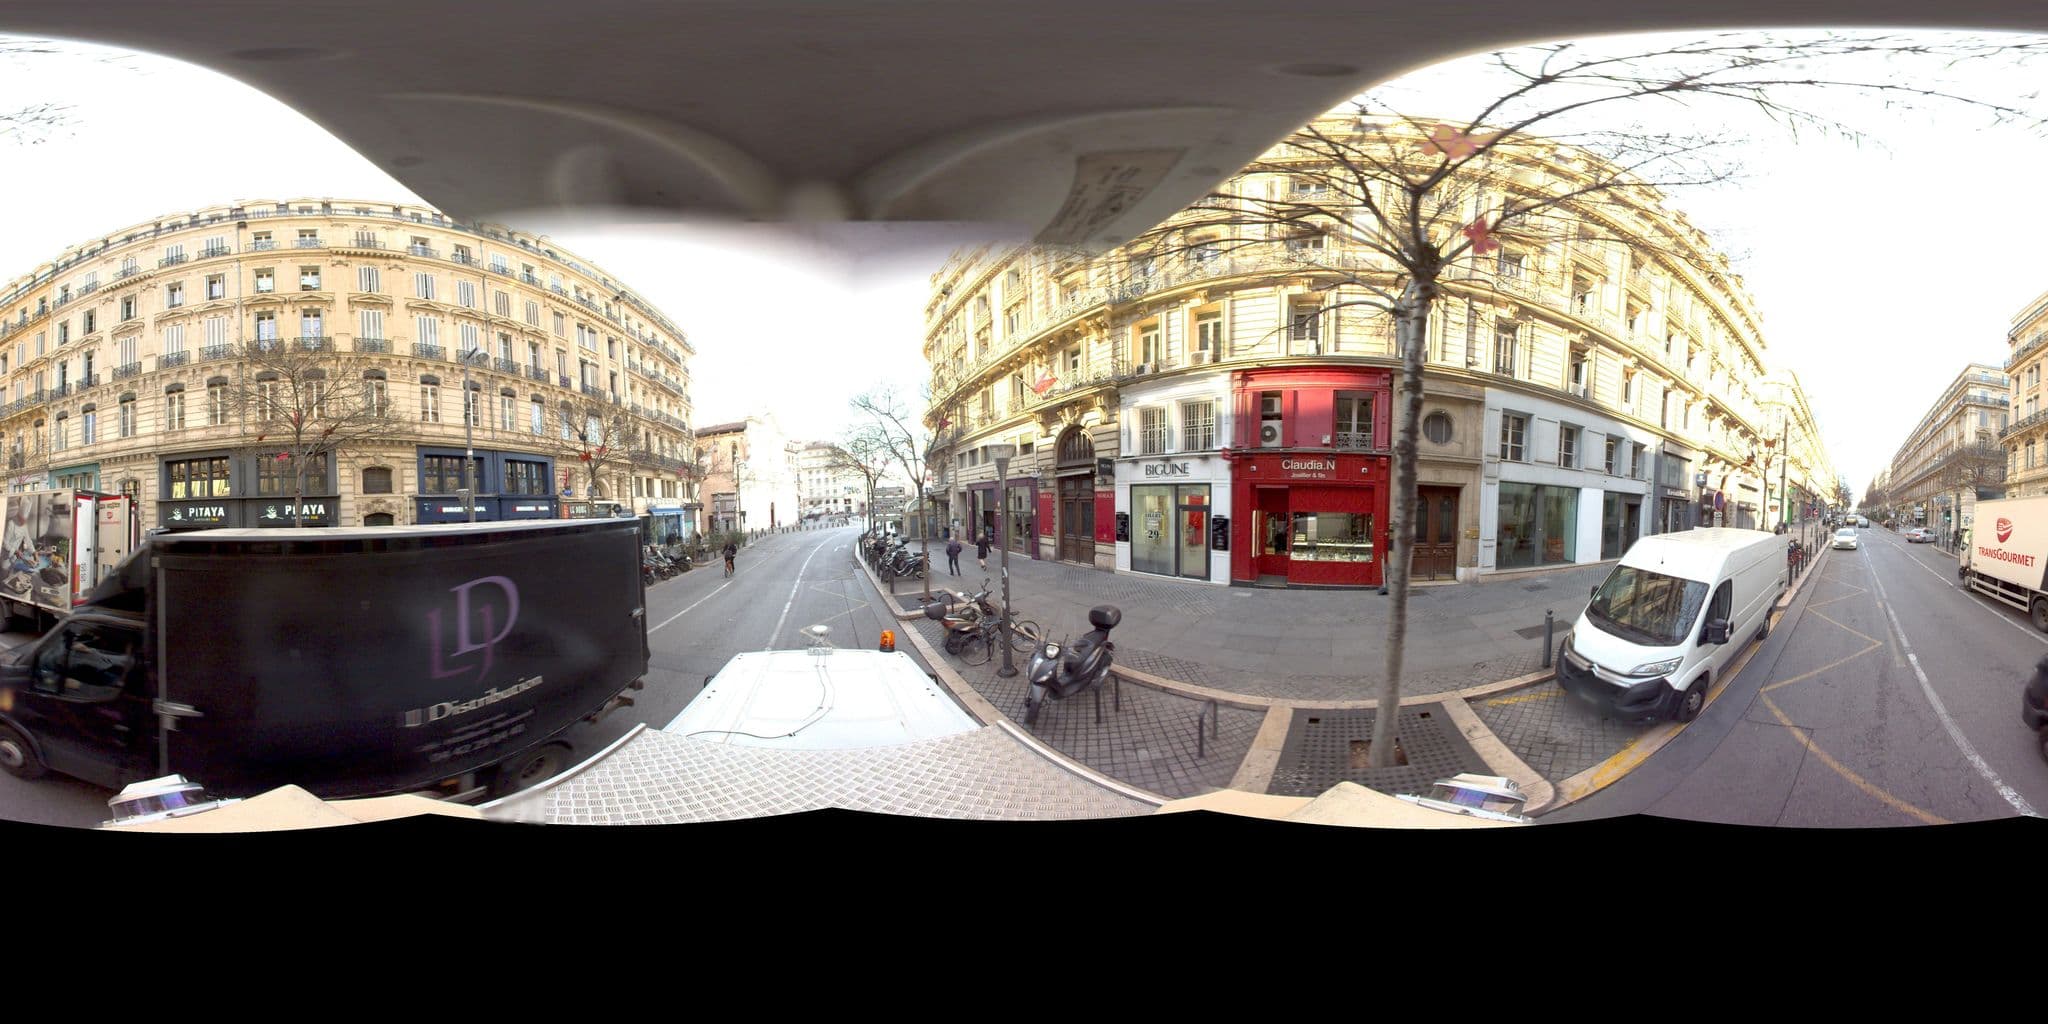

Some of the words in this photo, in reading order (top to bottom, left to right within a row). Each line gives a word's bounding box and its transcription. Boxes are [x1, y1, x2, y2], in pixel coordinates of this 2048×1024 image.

[1145, 462, 1189, 475] BIGUINE
[1282, 459, 1335, 470] Claudia.N
[188, 506, 225, 517] PITAYA
[285, 504, 325, 515] PIAYA
[1148, 529, 1159, 539] 29
